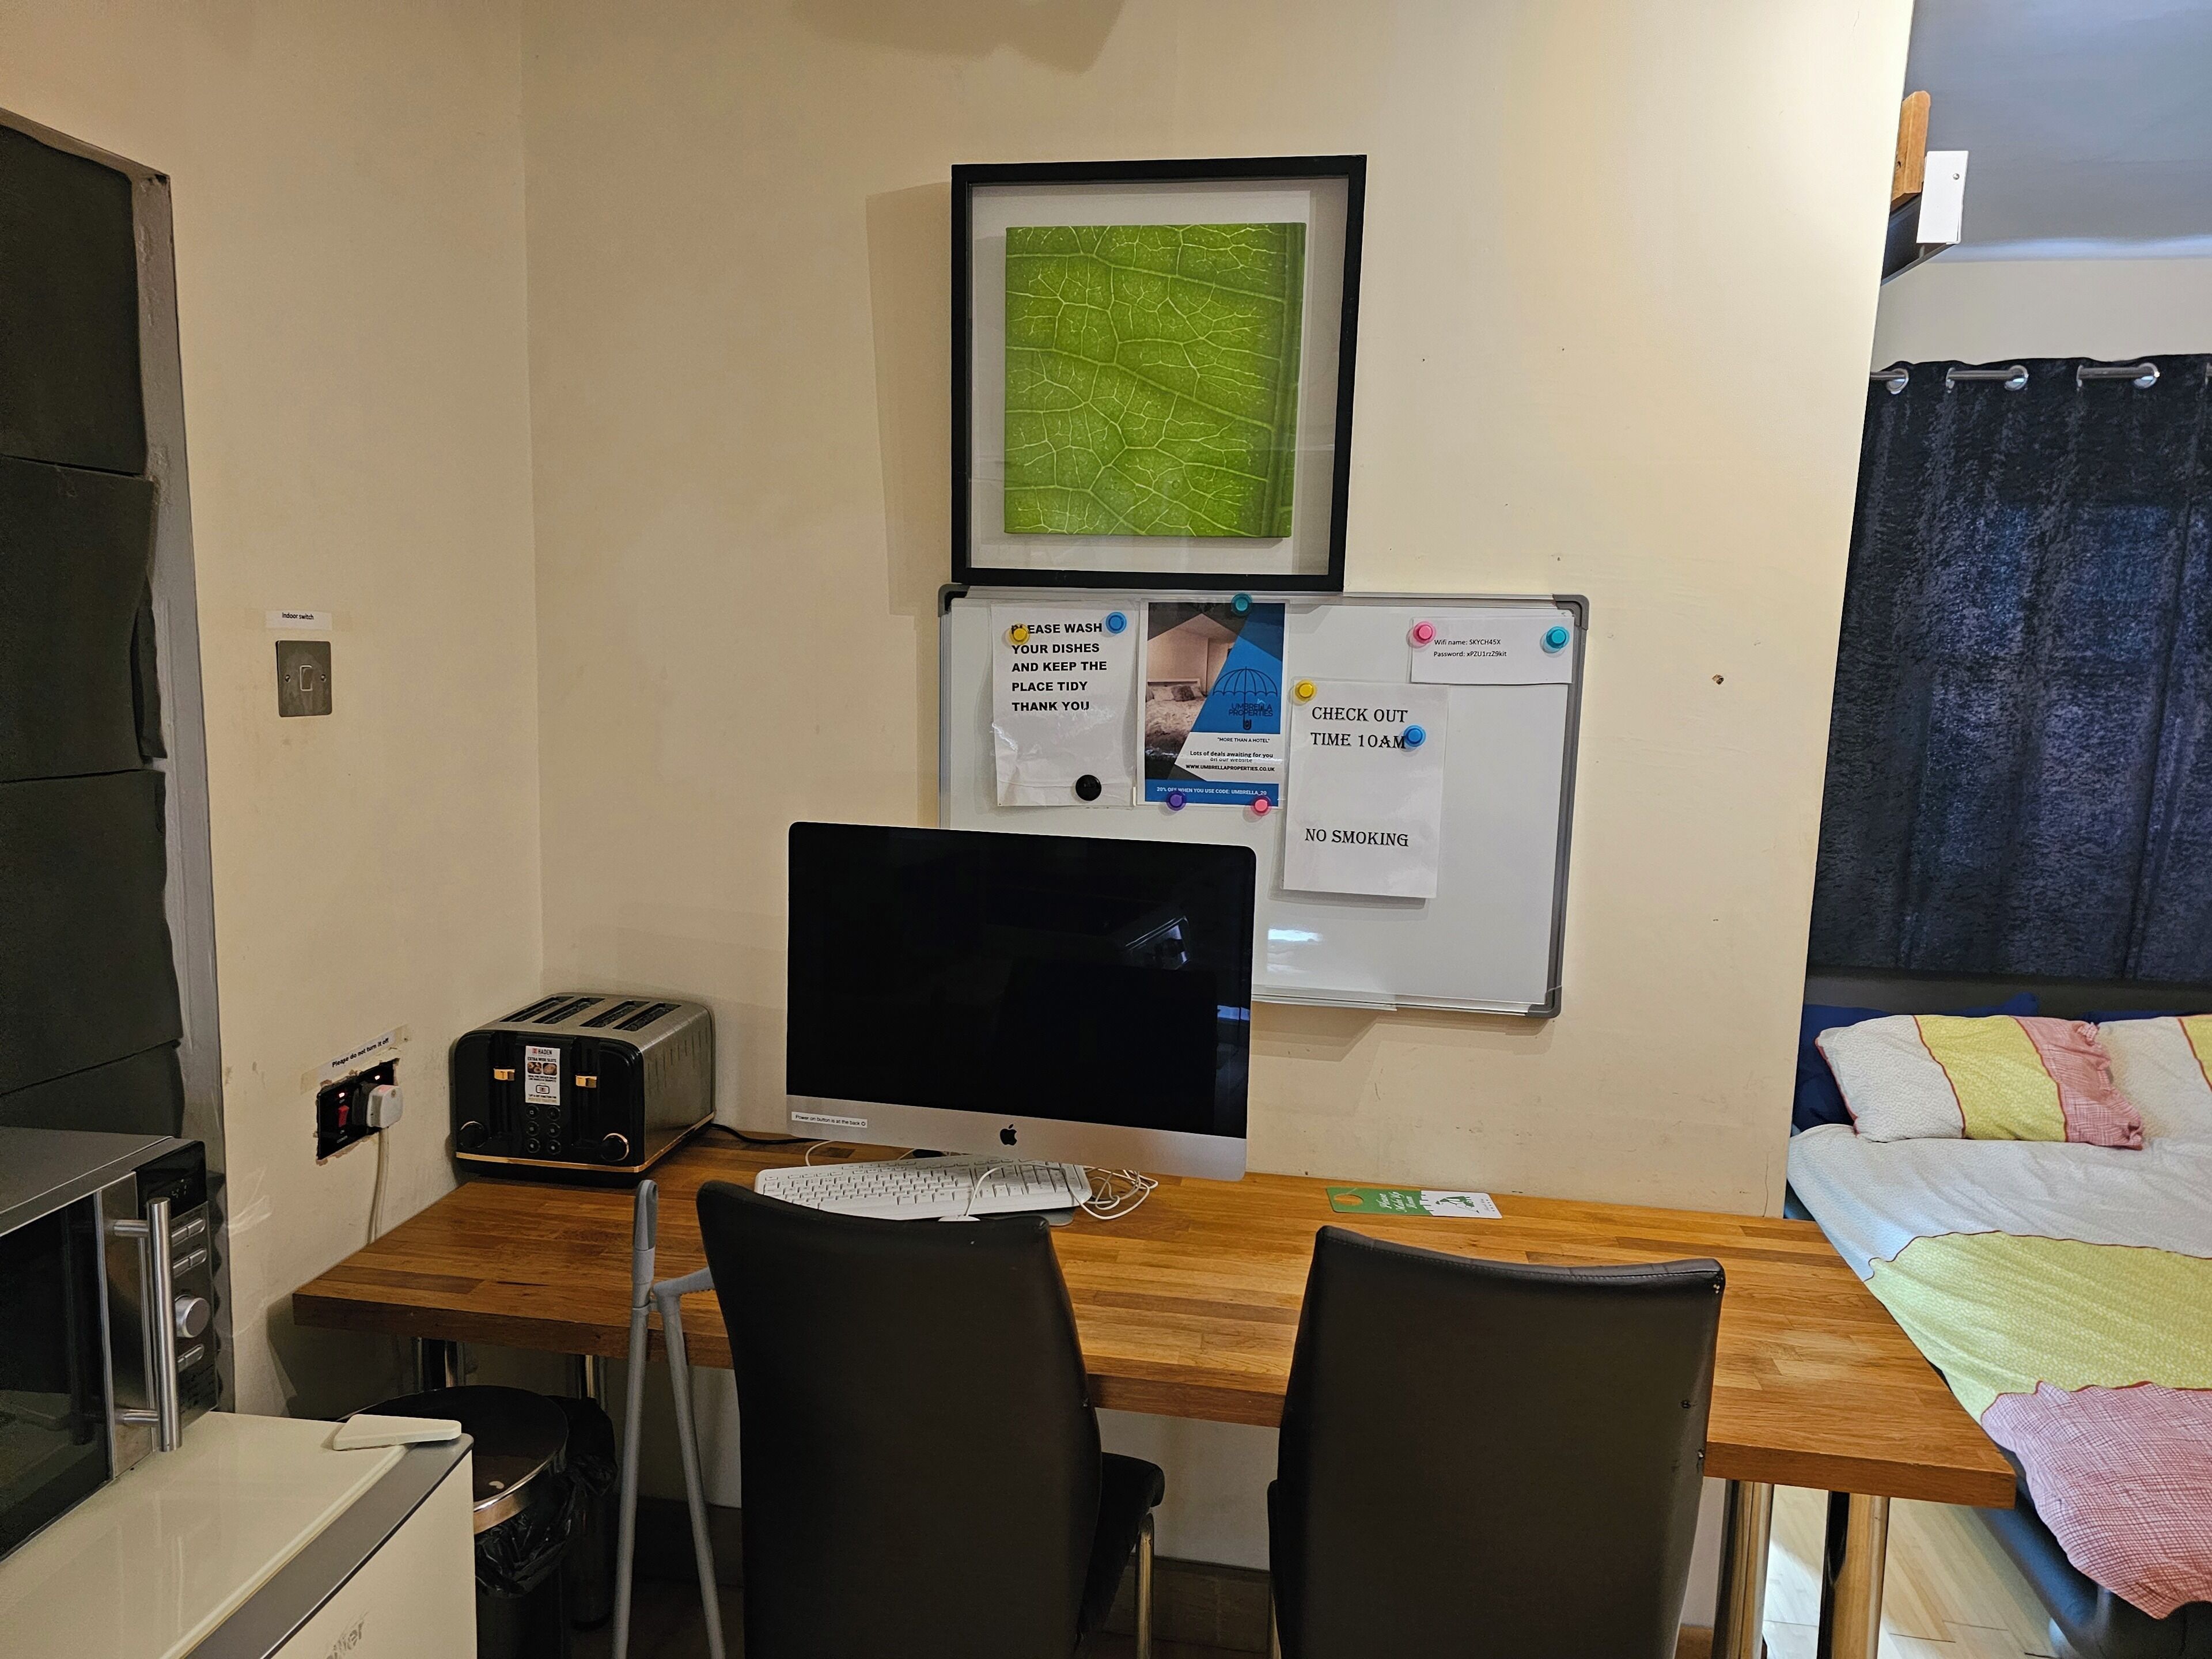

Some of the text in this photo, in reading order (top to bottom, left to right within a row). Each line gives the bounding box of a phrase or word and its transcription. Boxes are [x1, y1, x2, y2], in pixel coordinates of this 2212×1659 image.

[1064, 623, 1103, 633] WASH
[1012, 643, 1100, 654] YOUR DISHES
[1012, 661, 1107, 672] AND KEEP THE
[1012, 681, 1088, 691] PLACE TIDY
[1012, 701, 1089, 711] THANK YOU
[1232, 703, 1272, 711] UMBRELLA
[1312, 706, 1408, 723] CHECK OUT
[1310, 732, 1407, 749] TIME 10AM
[1305, 828, 1410, 847] NO SMOKING
[332, 1056, 349, 1067] Please
[357, 1048, 366, 1056] not
[366, 1044, 377, 1052] turn
